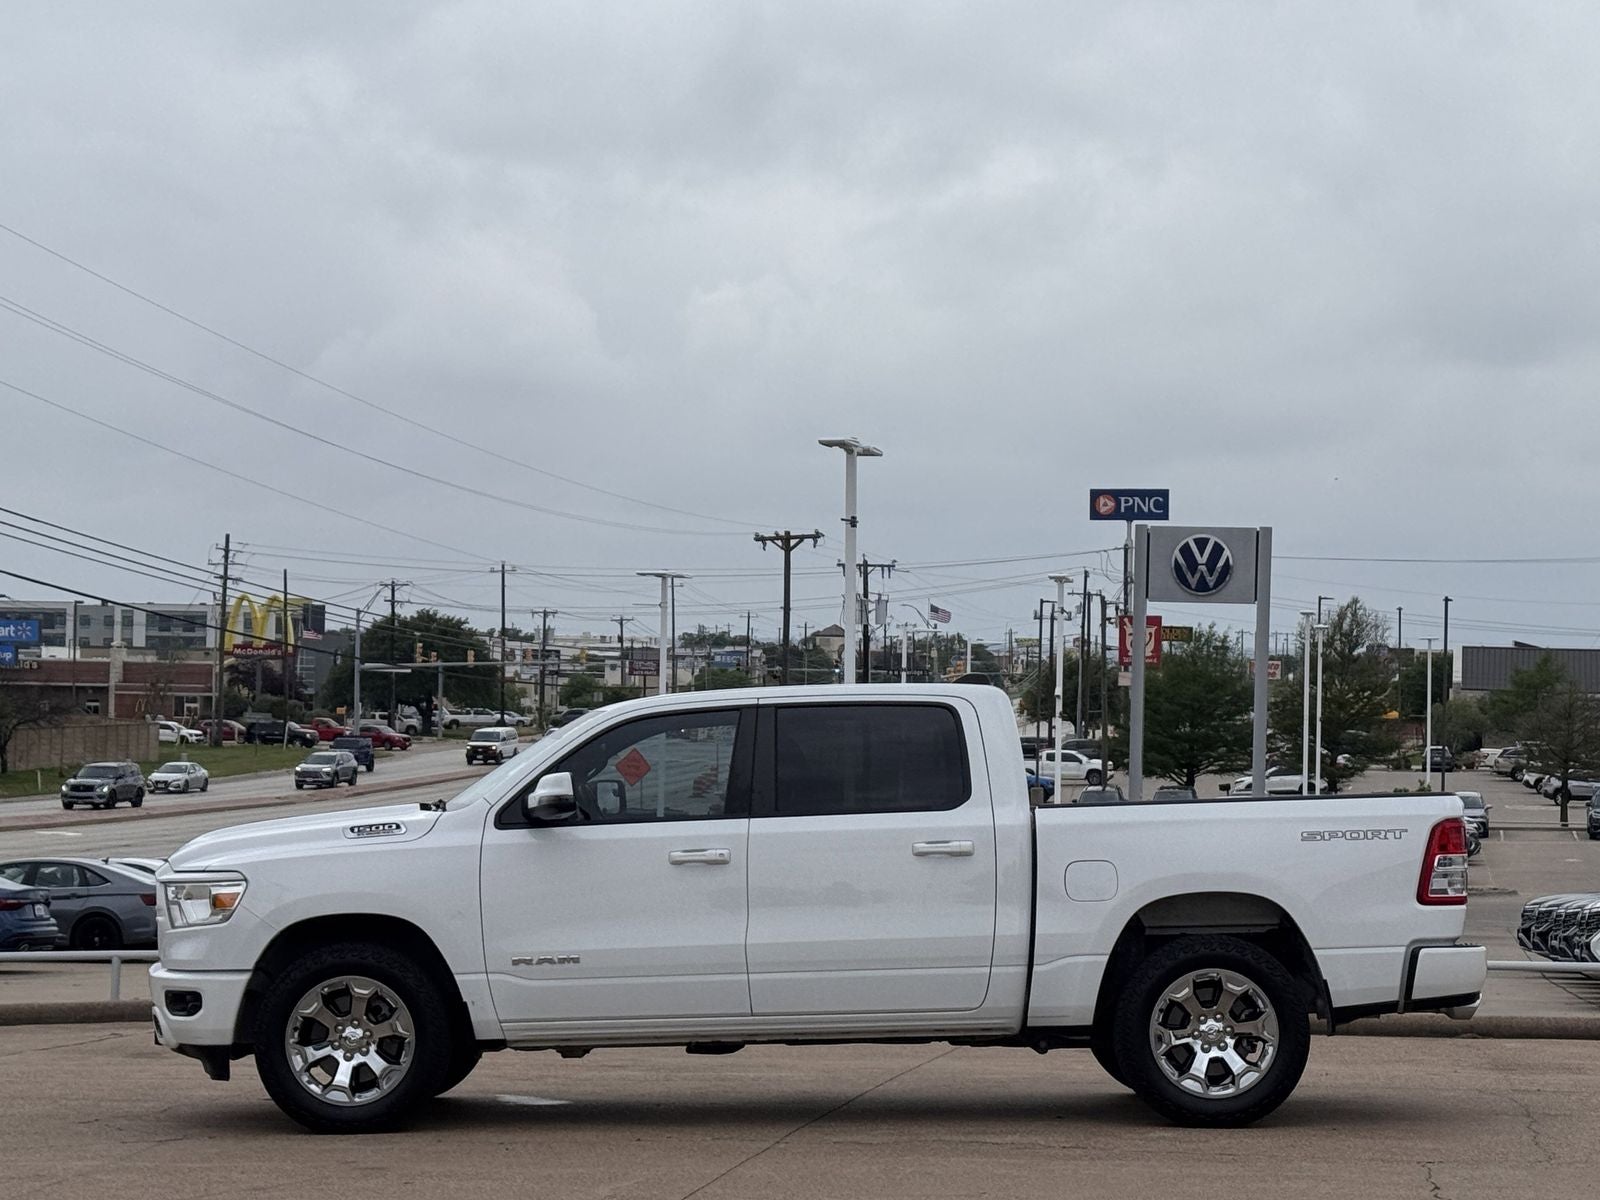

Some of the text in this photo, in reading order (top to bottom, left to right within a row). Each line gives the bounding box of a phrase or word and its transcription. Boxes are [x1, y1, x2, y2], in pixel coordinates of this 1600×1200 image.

[1118, 496, 1164, 513] PNC
[233, 647, 282, 656] McDonald's
[1300, 829, 1408, 842] SPORT
[511, 955, 580, 966] RAM
